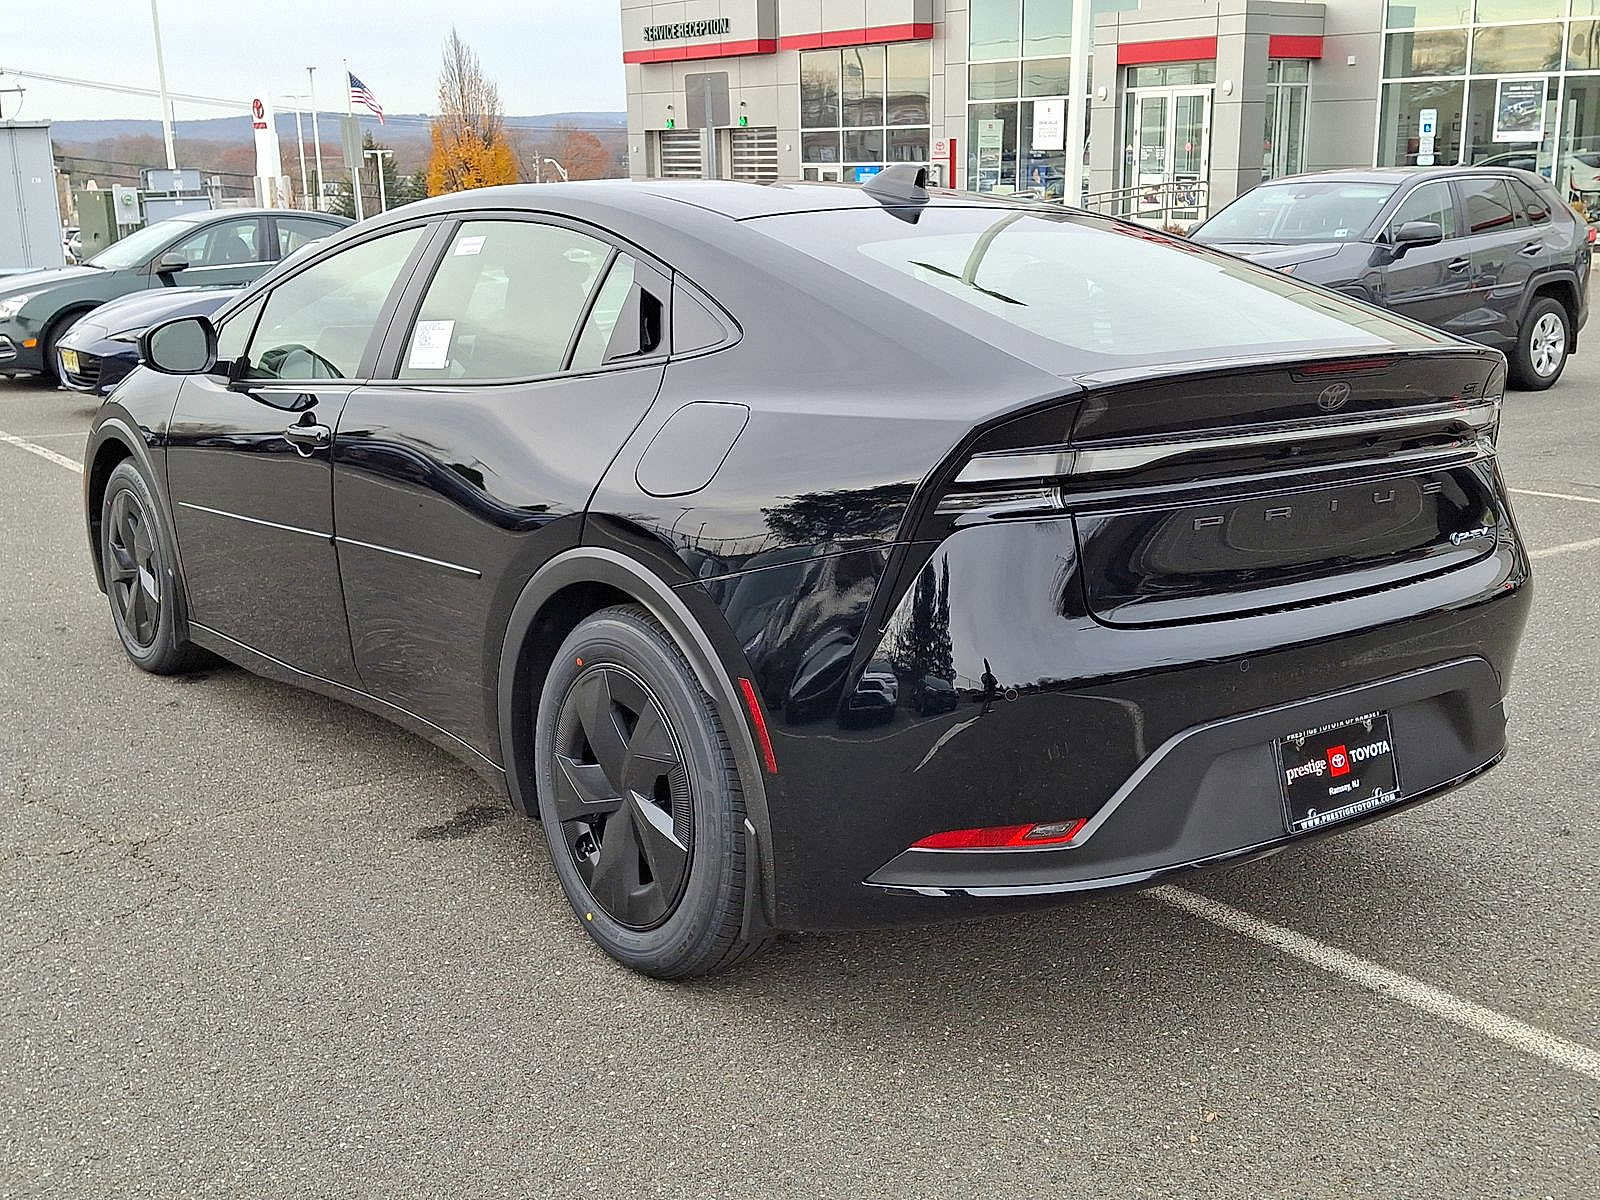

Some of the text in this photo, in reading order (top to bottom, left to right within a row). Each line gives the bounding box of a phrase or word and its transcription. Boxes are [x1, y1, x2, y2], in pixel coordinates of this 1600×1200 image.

[644, 18, 729, 41] SERVICE RECEPTION
[1286, 740, 1391, 785] prestige TOYOTA
